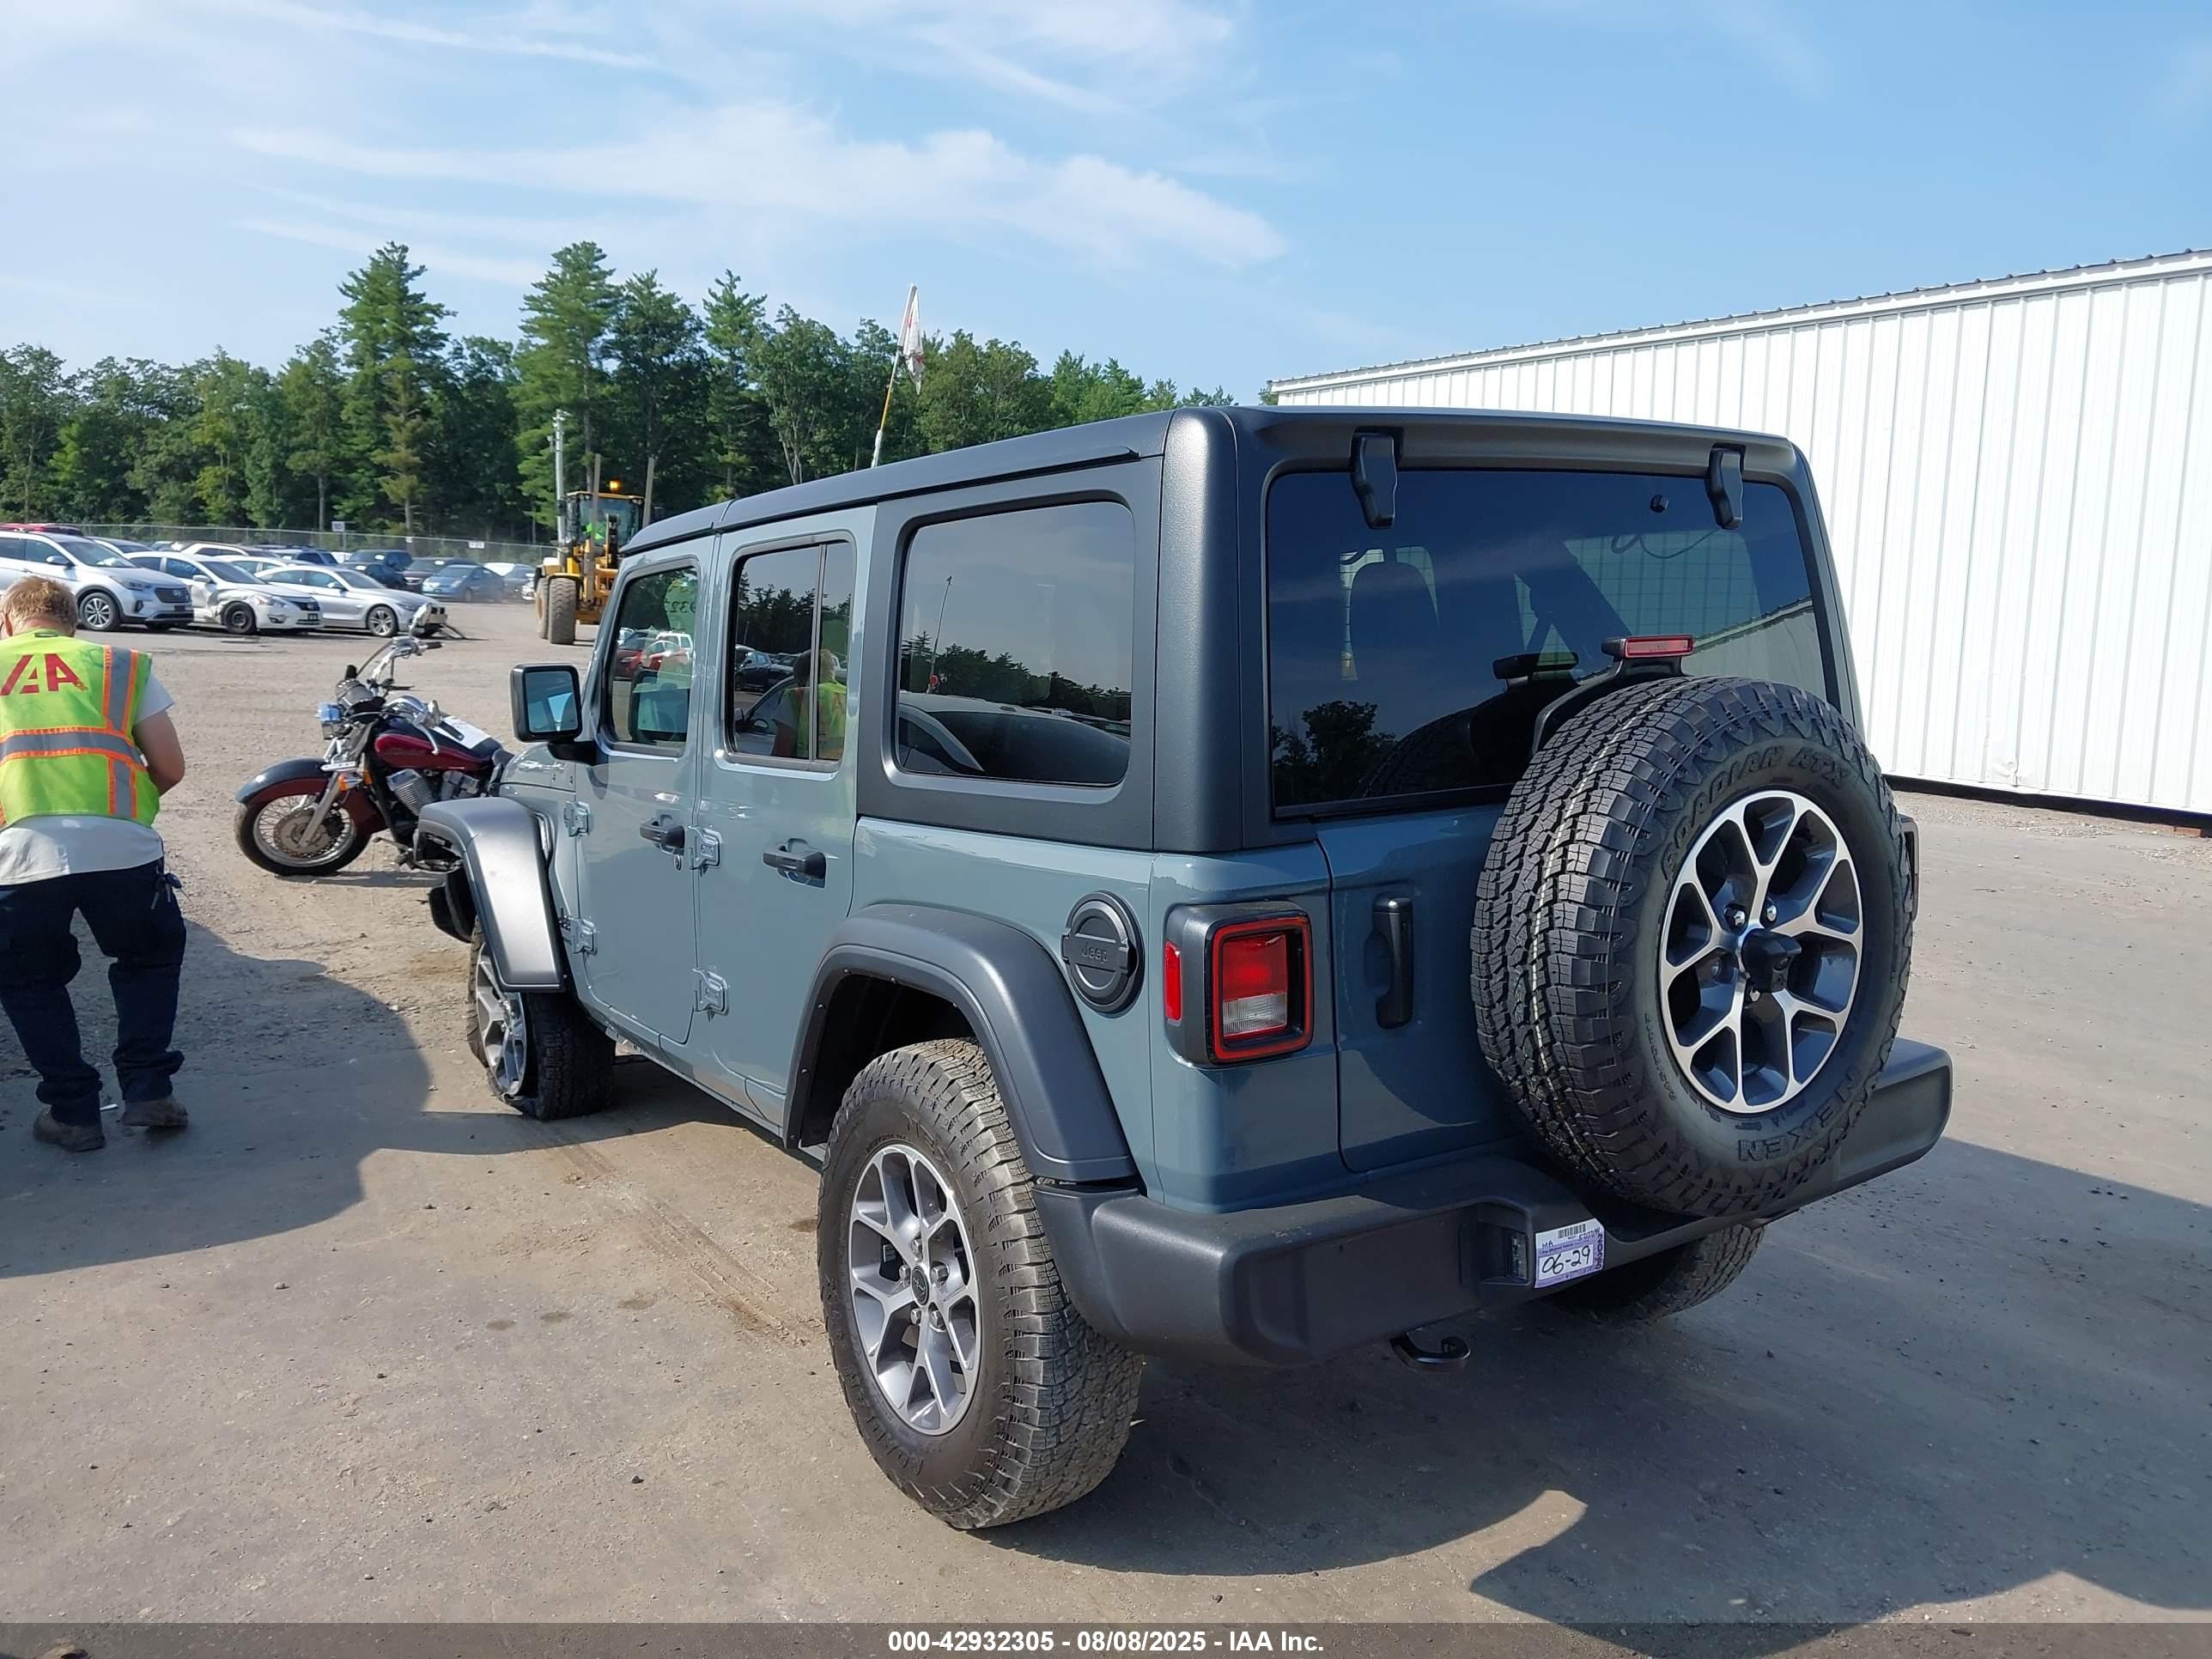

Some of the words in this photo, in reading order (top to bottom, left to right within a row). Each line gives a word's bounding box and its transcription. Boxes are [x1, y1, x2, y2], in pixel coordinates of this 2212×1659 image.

[1081, 942, 1108, 964] Jeep
[1738, 1065, 1857, 1162] NEXEN
[1541, 1245, 1590, 1274] 06-29
